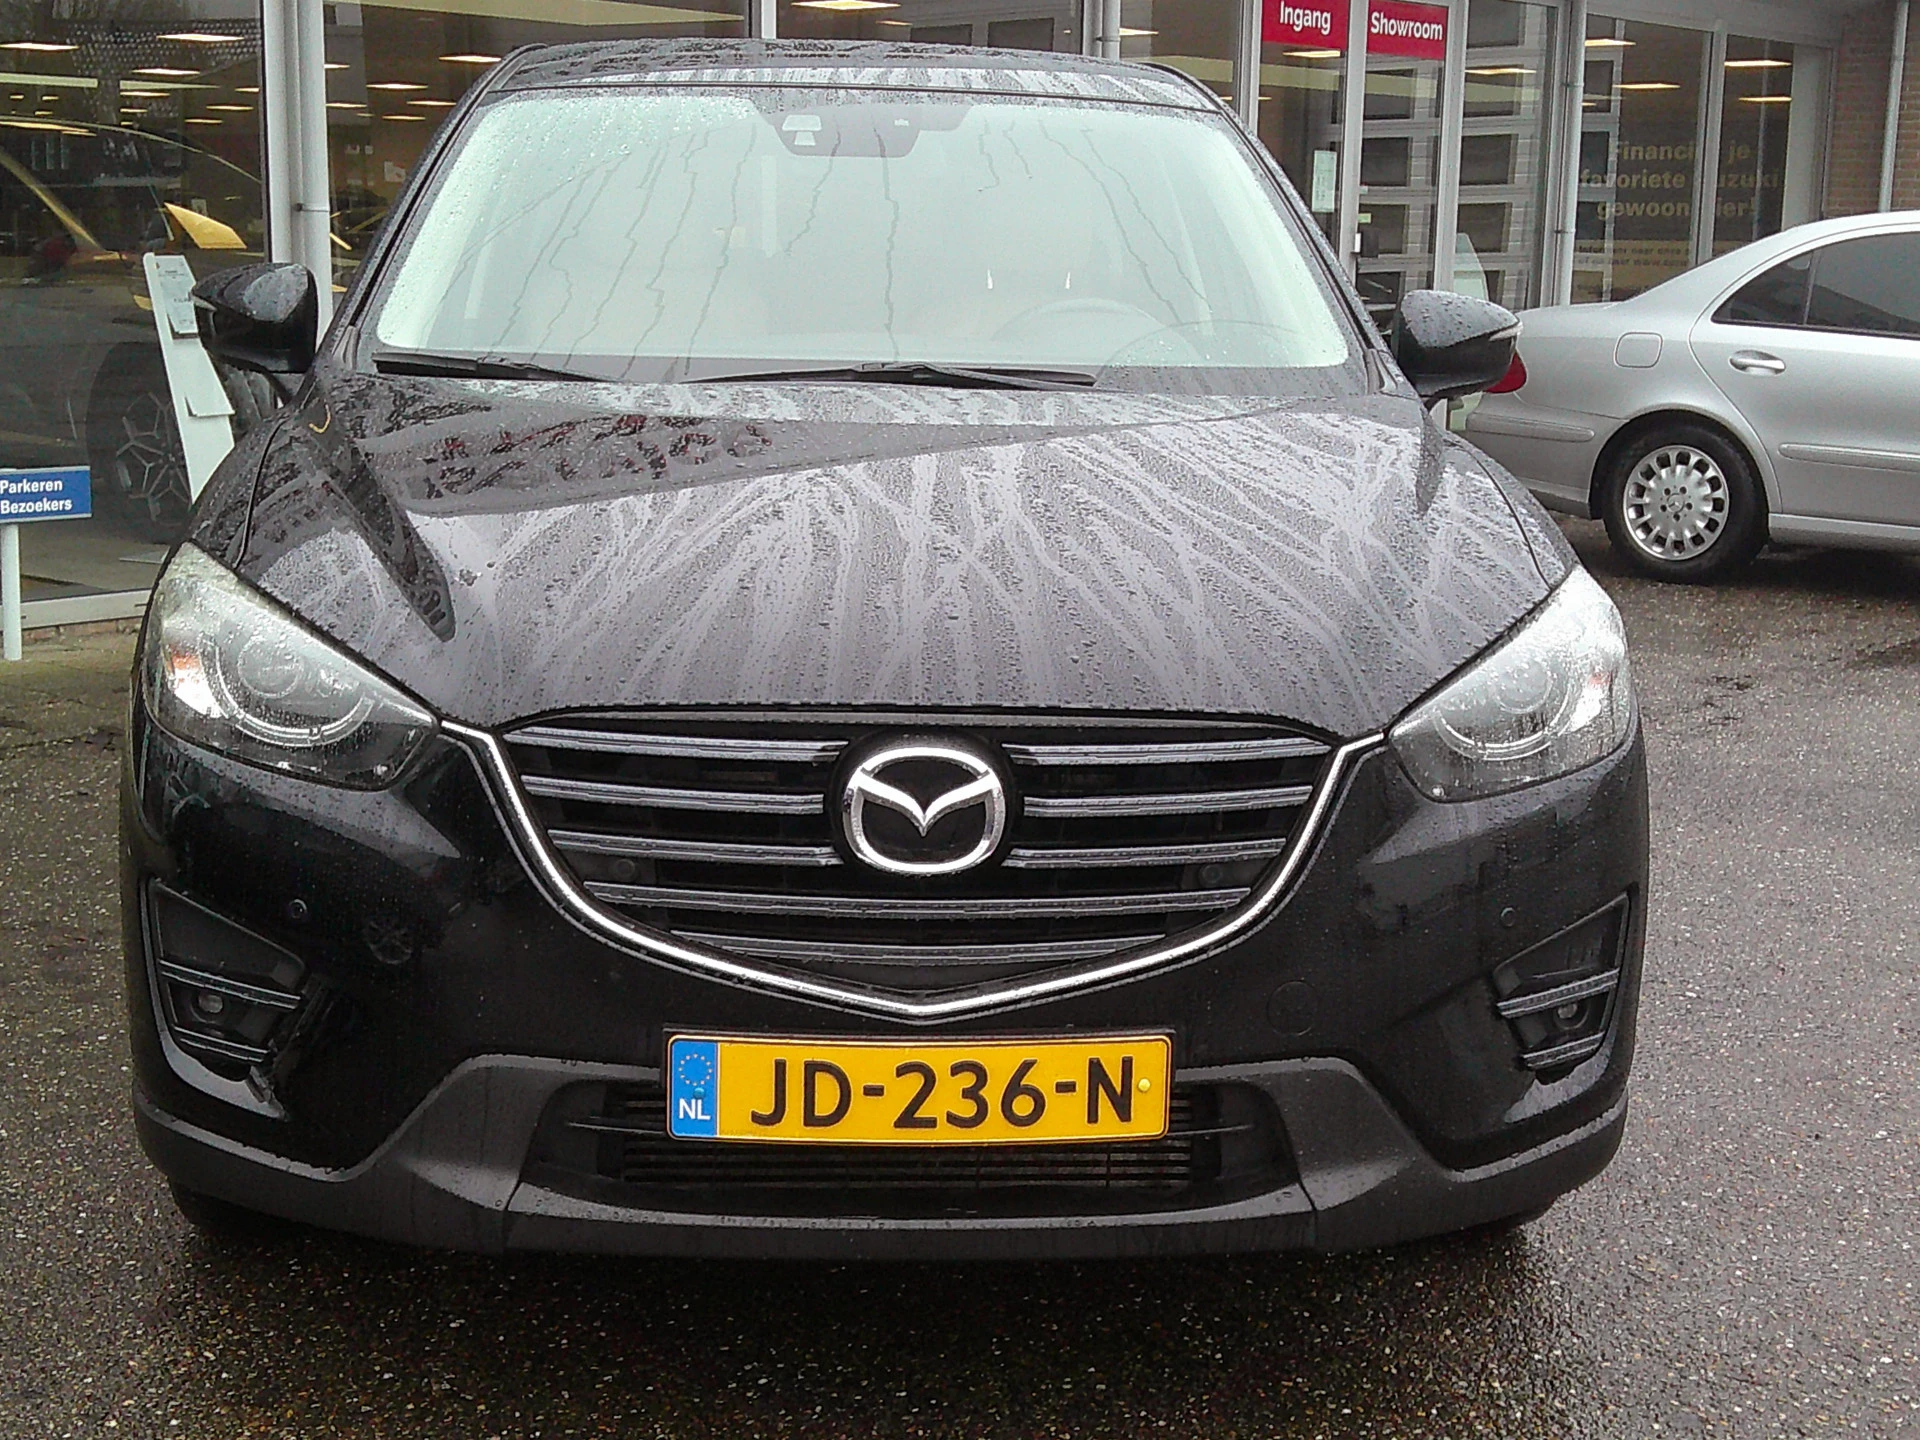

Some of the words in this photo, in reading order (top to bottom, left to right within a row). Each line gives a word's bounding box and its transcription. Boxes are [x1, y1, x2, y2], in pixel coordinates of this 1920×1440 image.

[1279, 1, 1332, 35] Ingang
[1370, 11, 1443, 41] Showroom
[0, 478, 63, 494] Parkeren
[0, 497, 73, 514] Bezoekers
[749, 1056, 1134, 1129] JD-236-N
[679, 1098, 711, 1120] NL
